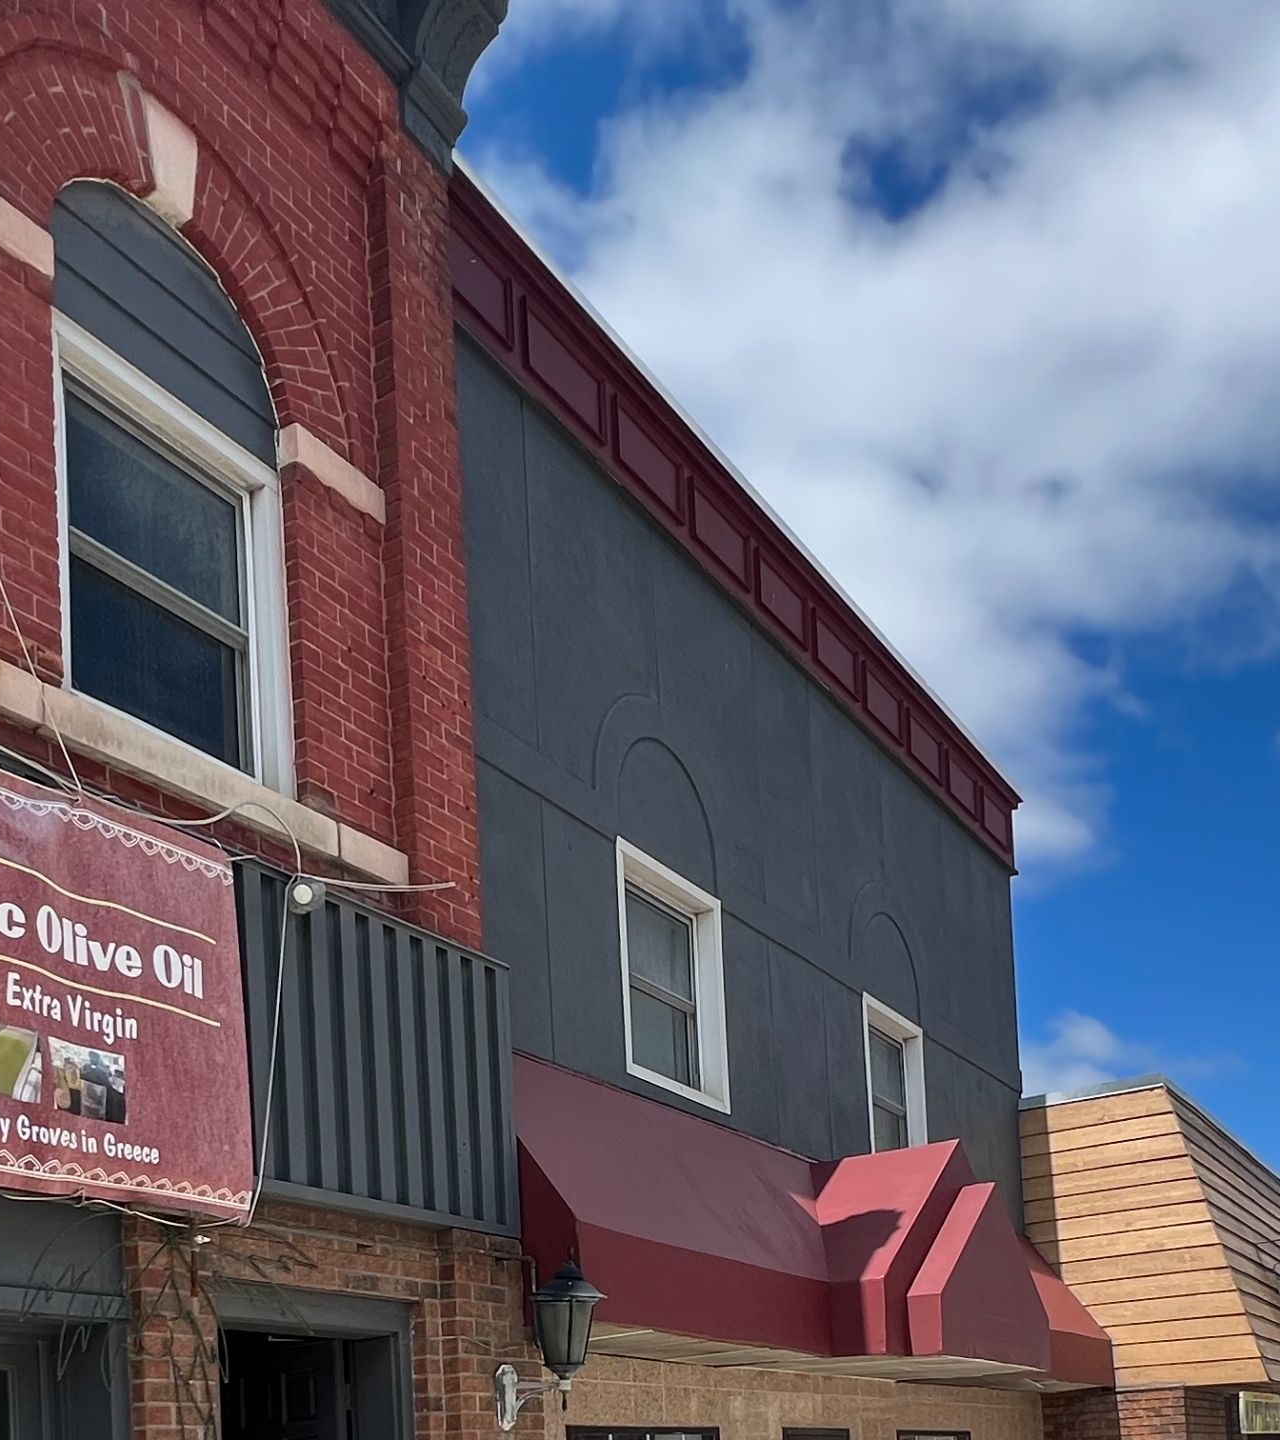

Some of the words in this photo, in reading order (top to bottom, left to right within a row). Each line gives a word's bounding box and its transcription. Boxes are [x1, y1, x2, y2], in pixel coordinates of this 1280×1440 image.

[35, 904, 143, 979] Olive
[152, 944, 203, 999] Oil
[6, 970, 62, 1022] Extra
[66, 997, 139, 1046] Virgin
[16, 1115, 78, 1151] Groves
[80, 1130, 98, 1154] in
[103, 1133, 160, 1165] Greece
